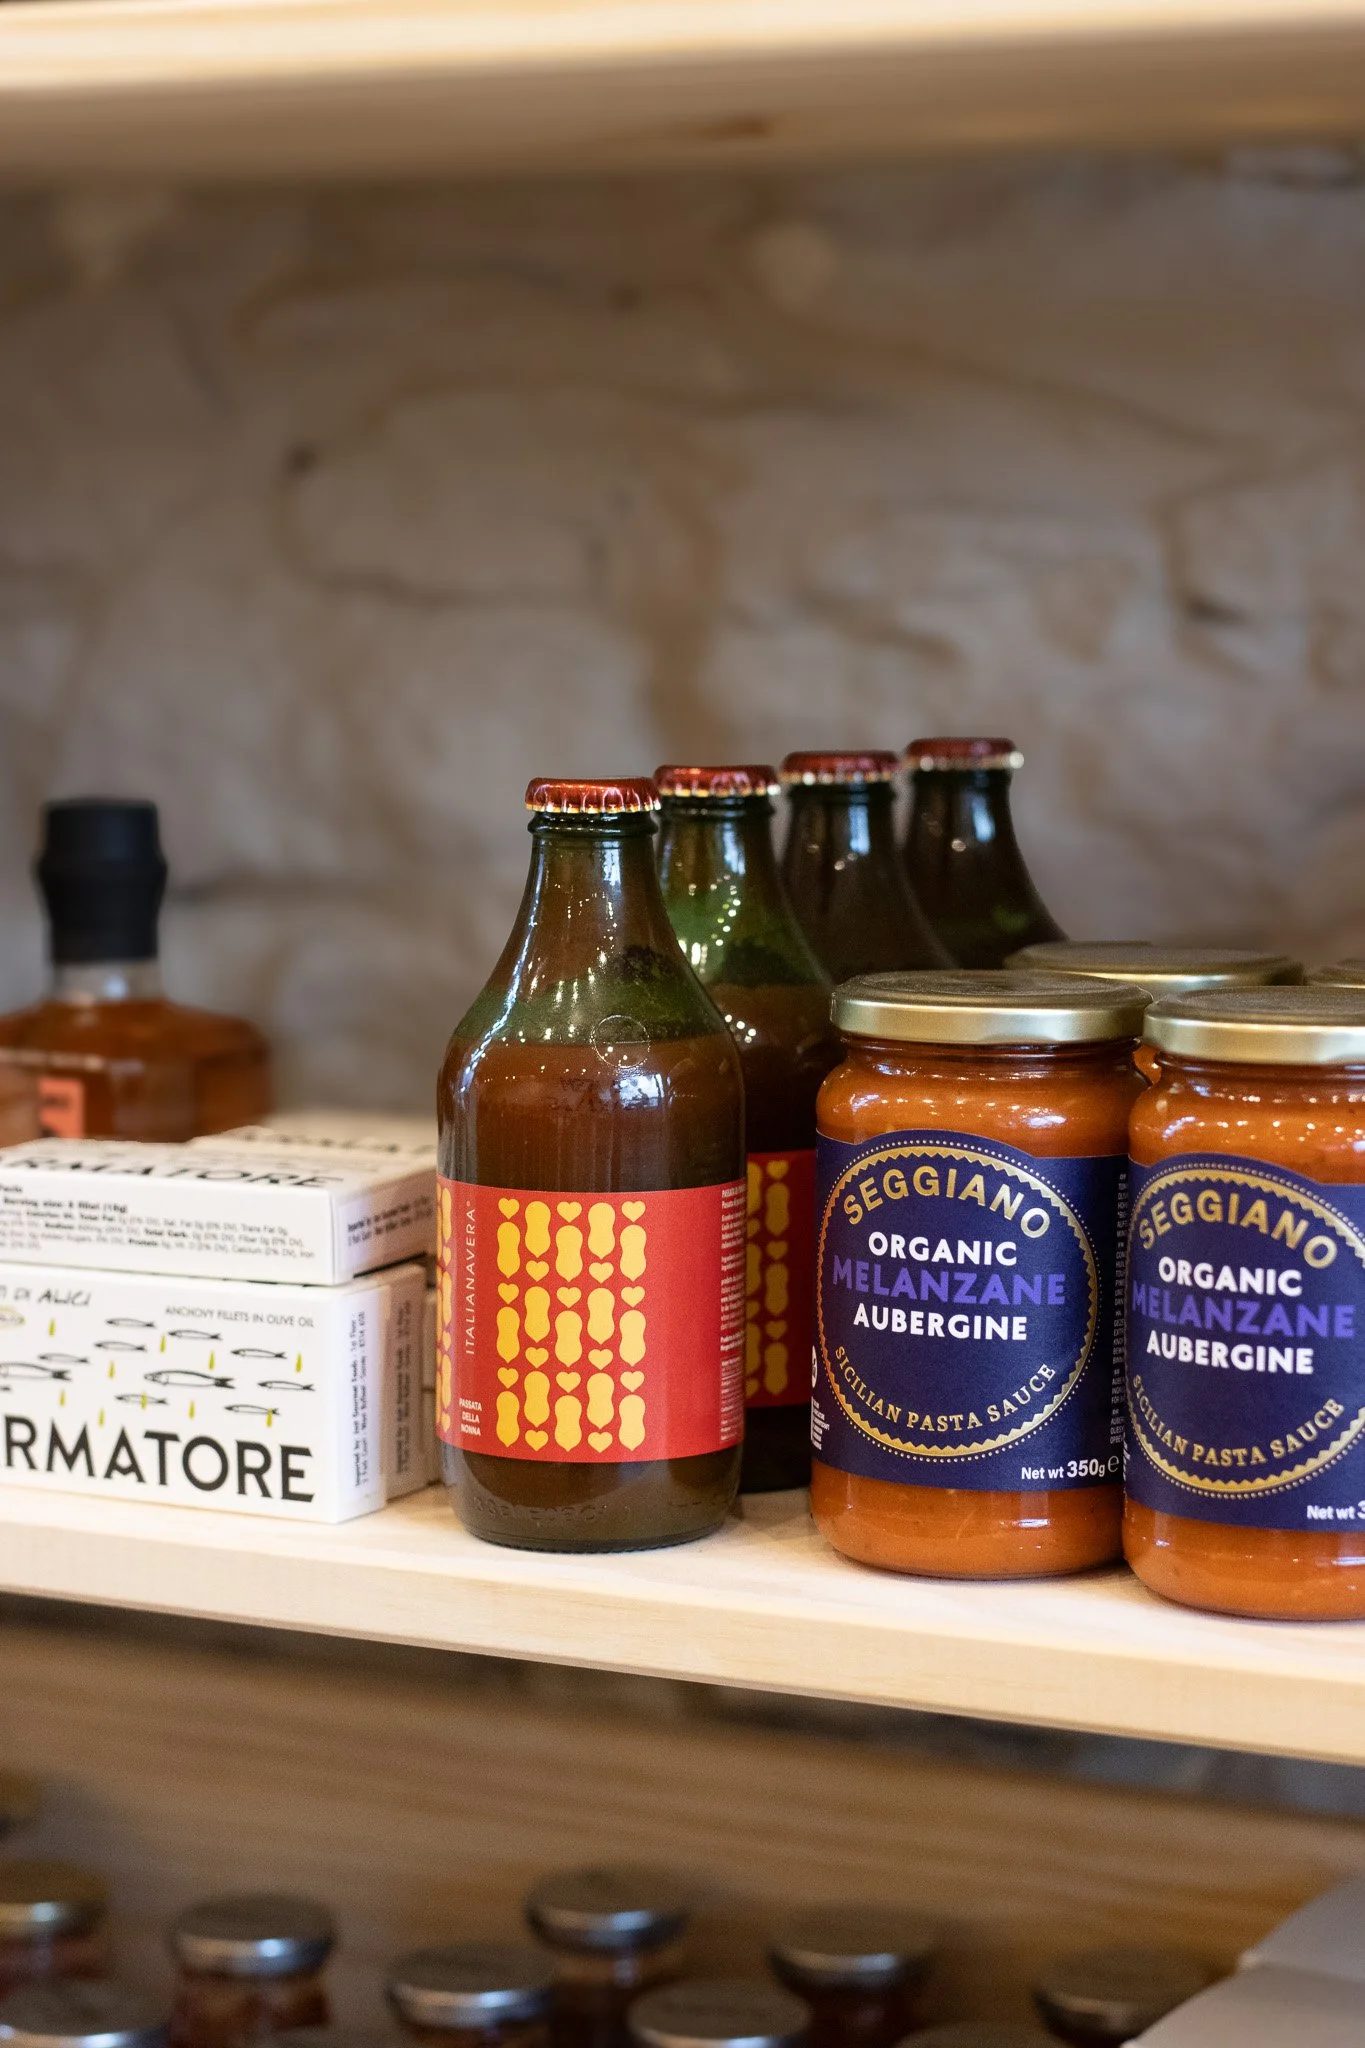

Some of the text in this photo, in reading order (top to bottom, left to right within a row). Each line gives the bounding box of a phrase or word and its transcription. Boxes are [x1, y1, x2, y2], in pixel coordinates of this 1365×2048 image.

[843, 1165, 1050, 1239] SEGGIANO
[868, 1231, 1018, 1266] ORGANIC
[1138, 1188, 1337, 1270] SEGGIANO
[832, 1254, 1066, 1305] MELANZANE
[1158, 1256, 1303, 1297] ORGANIC
[165, 1305, 214, 1318] ANCHOVY
[217, 1309, 249, 1322] FILLETS
[252, 1312, 264, 1323] IN
[267, 1314, 295, 1326] OLIVE
[853, 1302, 1028, 1341] AUBERGINE
[1131, 1278, 1355, 1339] MELANZANE
[1146, 1330, 1314, 1375] AUBERGINE
[459, 1398, 482, 1411] PASSATA
[835, 1345, 900, 1422] SICILIAN
[907, 1411, 982, 1433] PASTA
[987, 1363, 1056, 1421] SAUCE
[461, 1423, 481, 1436] NONNA
[462, 1411, 480, 1423] DELLA
[1131, 1374, 1188, 1456] SICILIAN
[1191, 1444, 1266, 1467] PASTA
[1270, 1398, 1345, 1460] SAUCE
[4, 1415, 315, 1503] RMATORE
[1022, 1466, 1045, 1480] Net
[1047, 1466, 1064, 1479] wt
[1306, 1504, 1334, 1520] Net
[1336, 1505, 1355, 1520] wt
